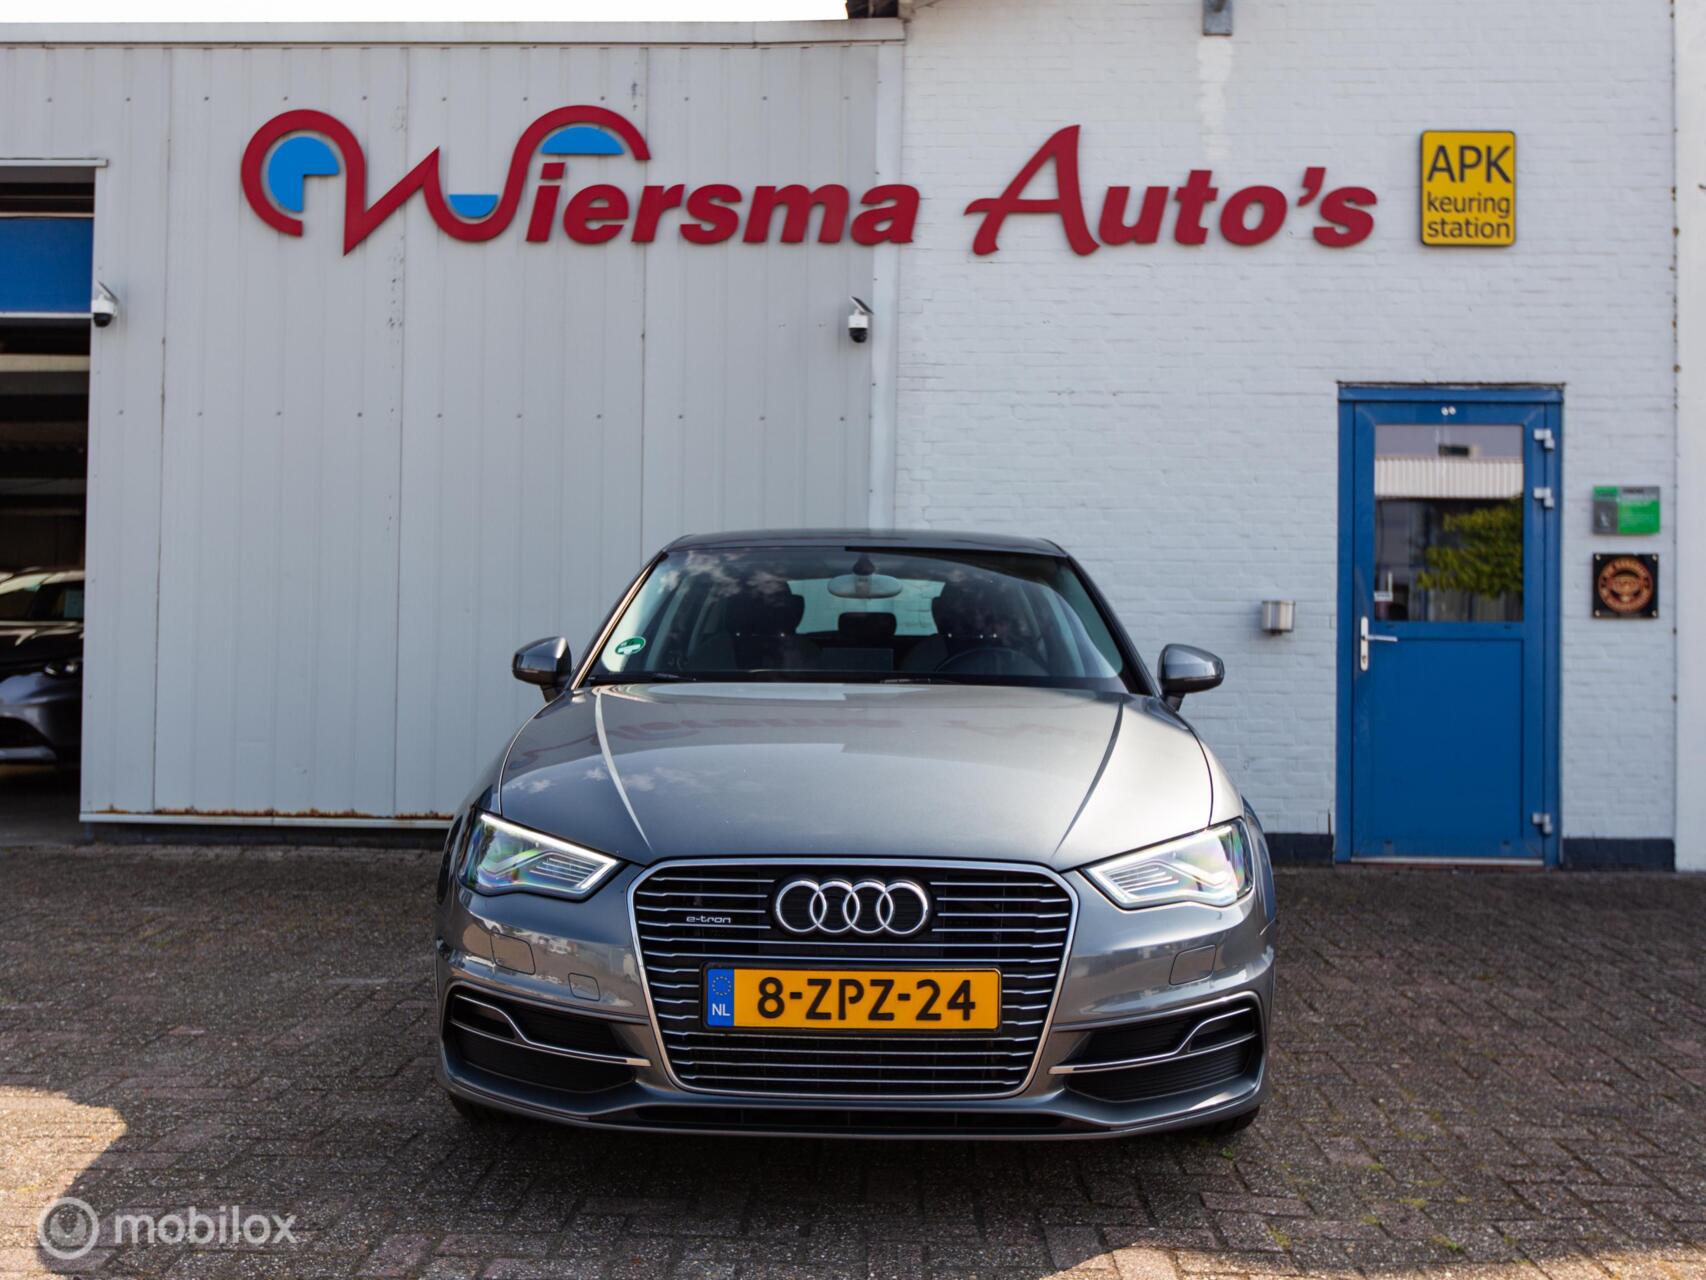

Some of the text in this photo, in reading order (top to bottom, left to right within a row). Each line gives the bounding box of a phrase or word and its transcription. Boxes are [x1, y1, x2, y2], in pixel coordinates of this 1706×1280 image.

[1427, 145, 1511, 183] APK
[241, 106, 1376, 255] Wiersma Auto's
[1427, 191, 1510, 219] keuring
[1427, 217, 1510, 239] station
[686, 915, 732, 924] e-tron
[711, 1003, 731, 1017] NL
[757, 976, 976, 1021] 8-ZPZ-24
